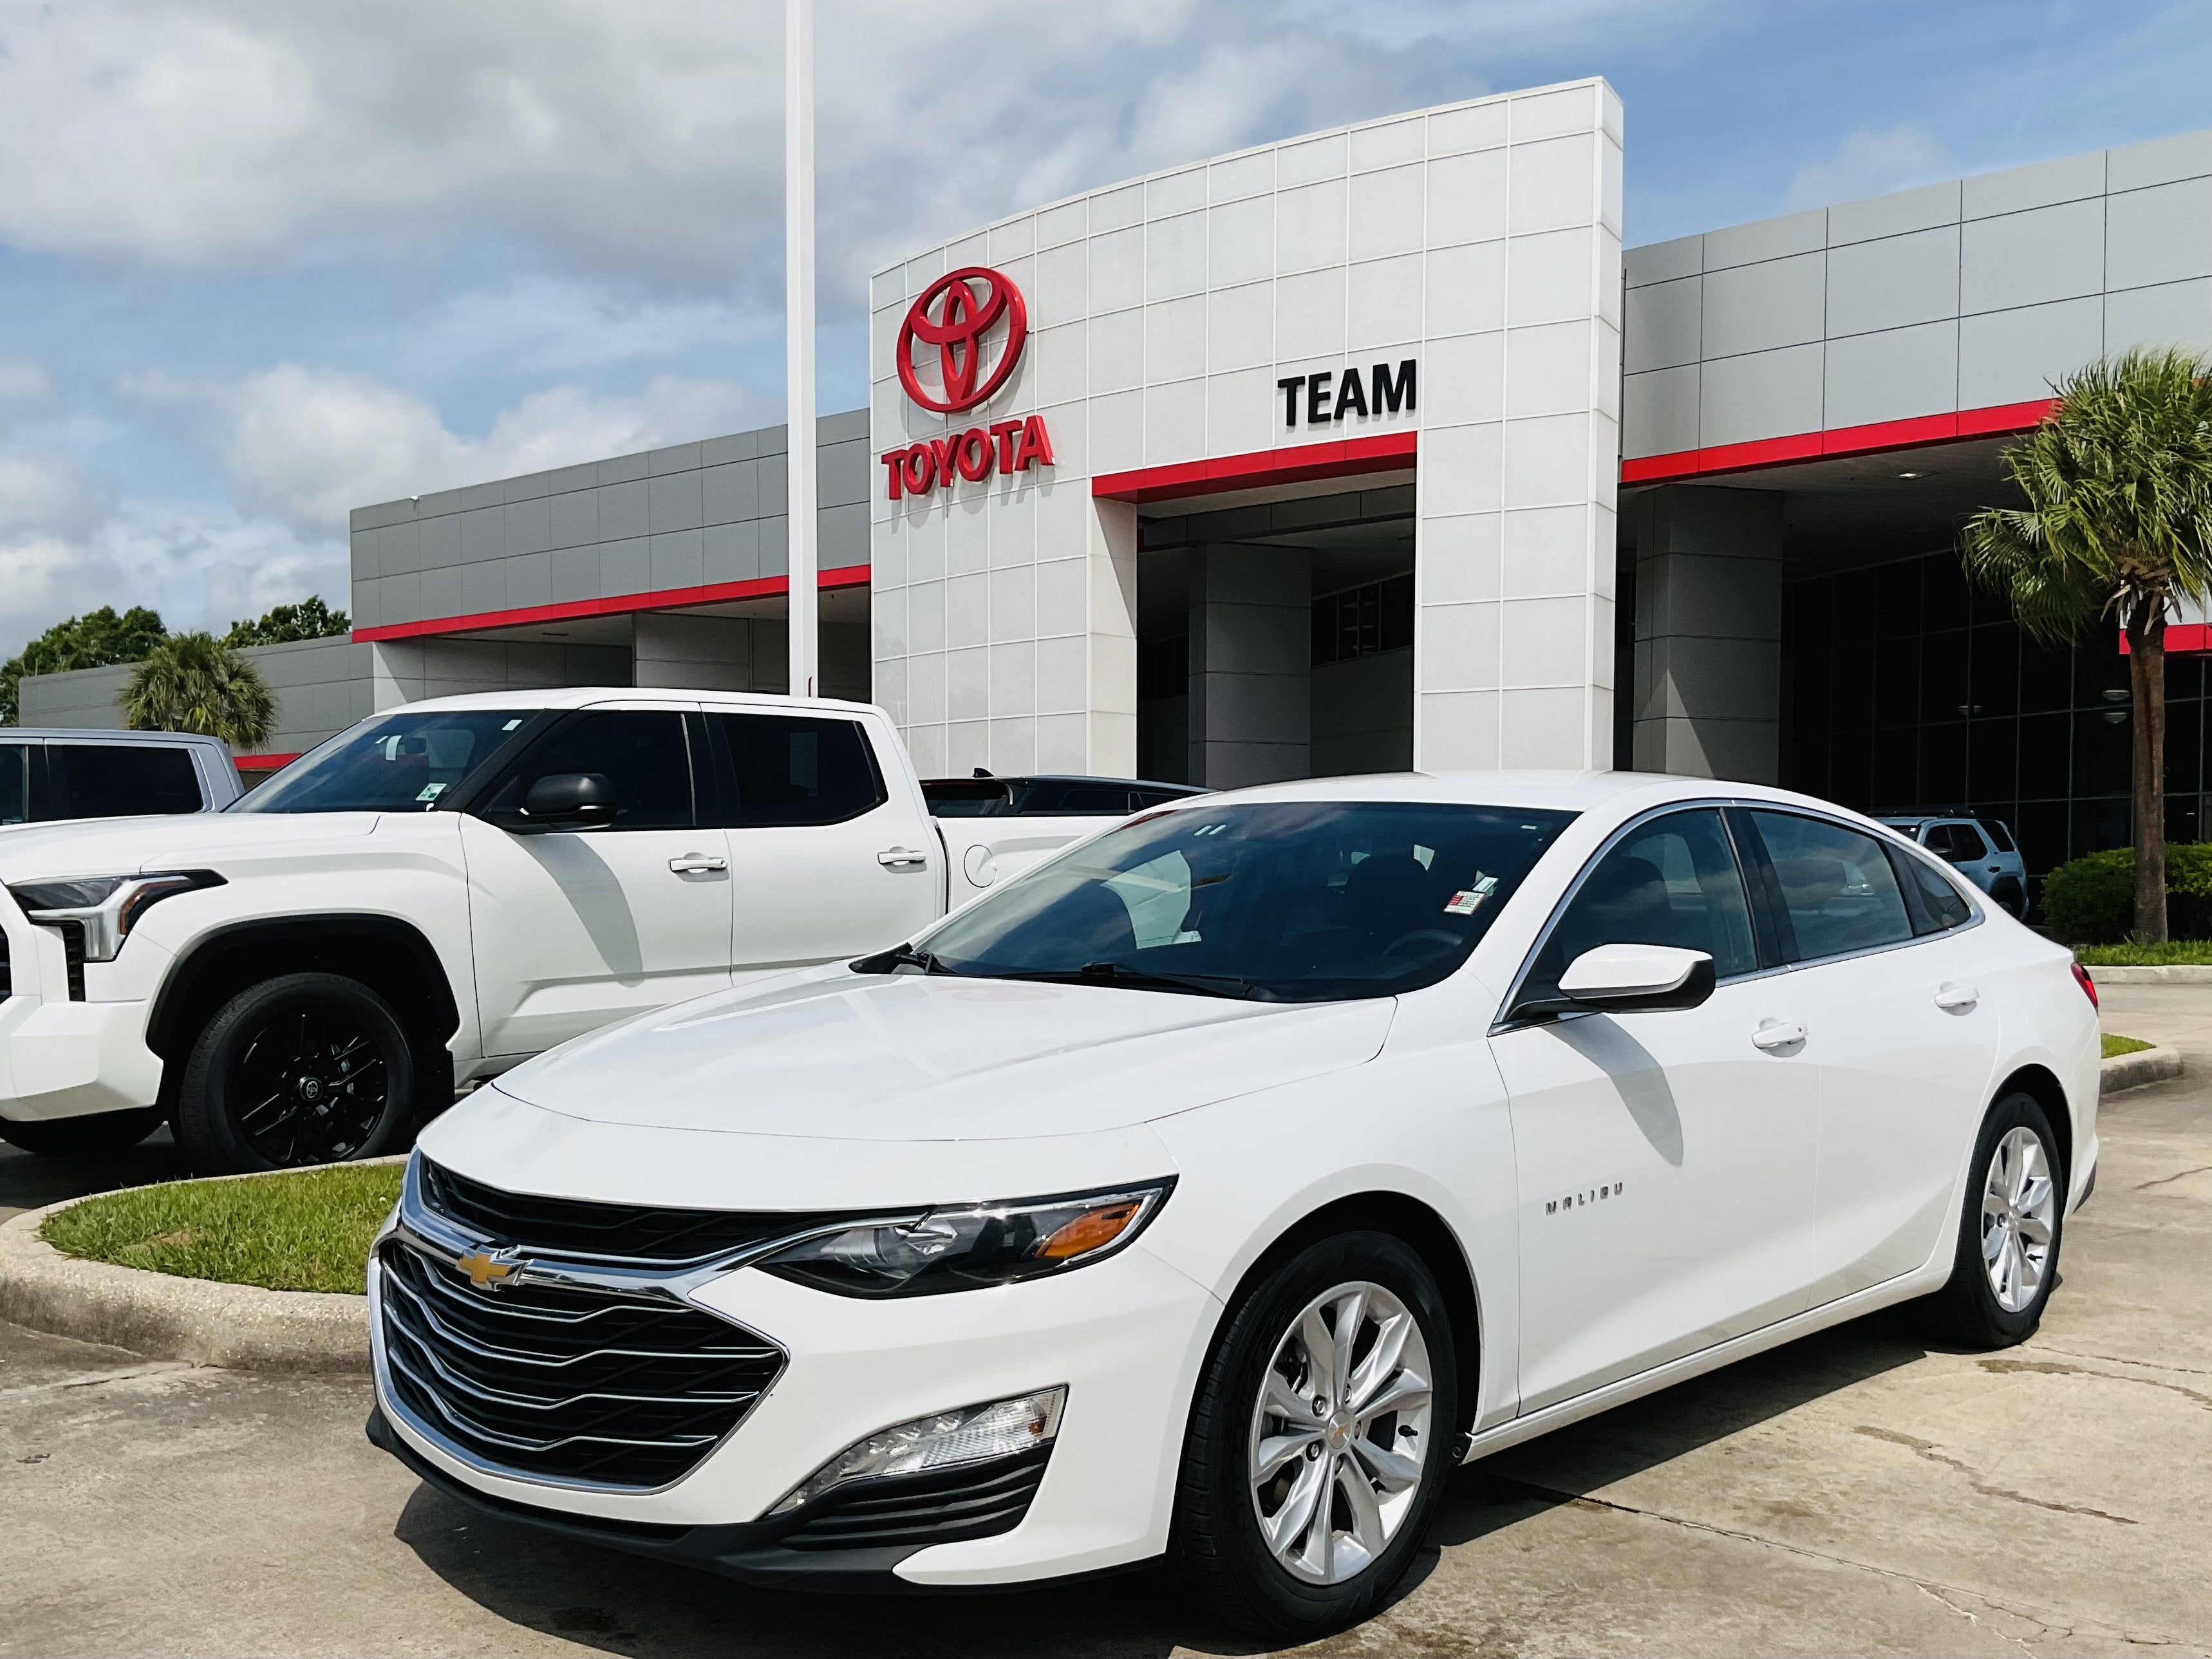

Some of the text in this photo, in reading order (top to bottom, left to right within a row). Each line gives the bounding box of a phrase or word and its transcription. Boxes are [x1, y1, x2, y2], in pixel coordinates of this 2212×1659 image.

[1277, 359, 1417, 427] TEAM
[881, 415, 1054, 500] TOYOTA
[1545, 1181, 1623, 1216] MALIBU
